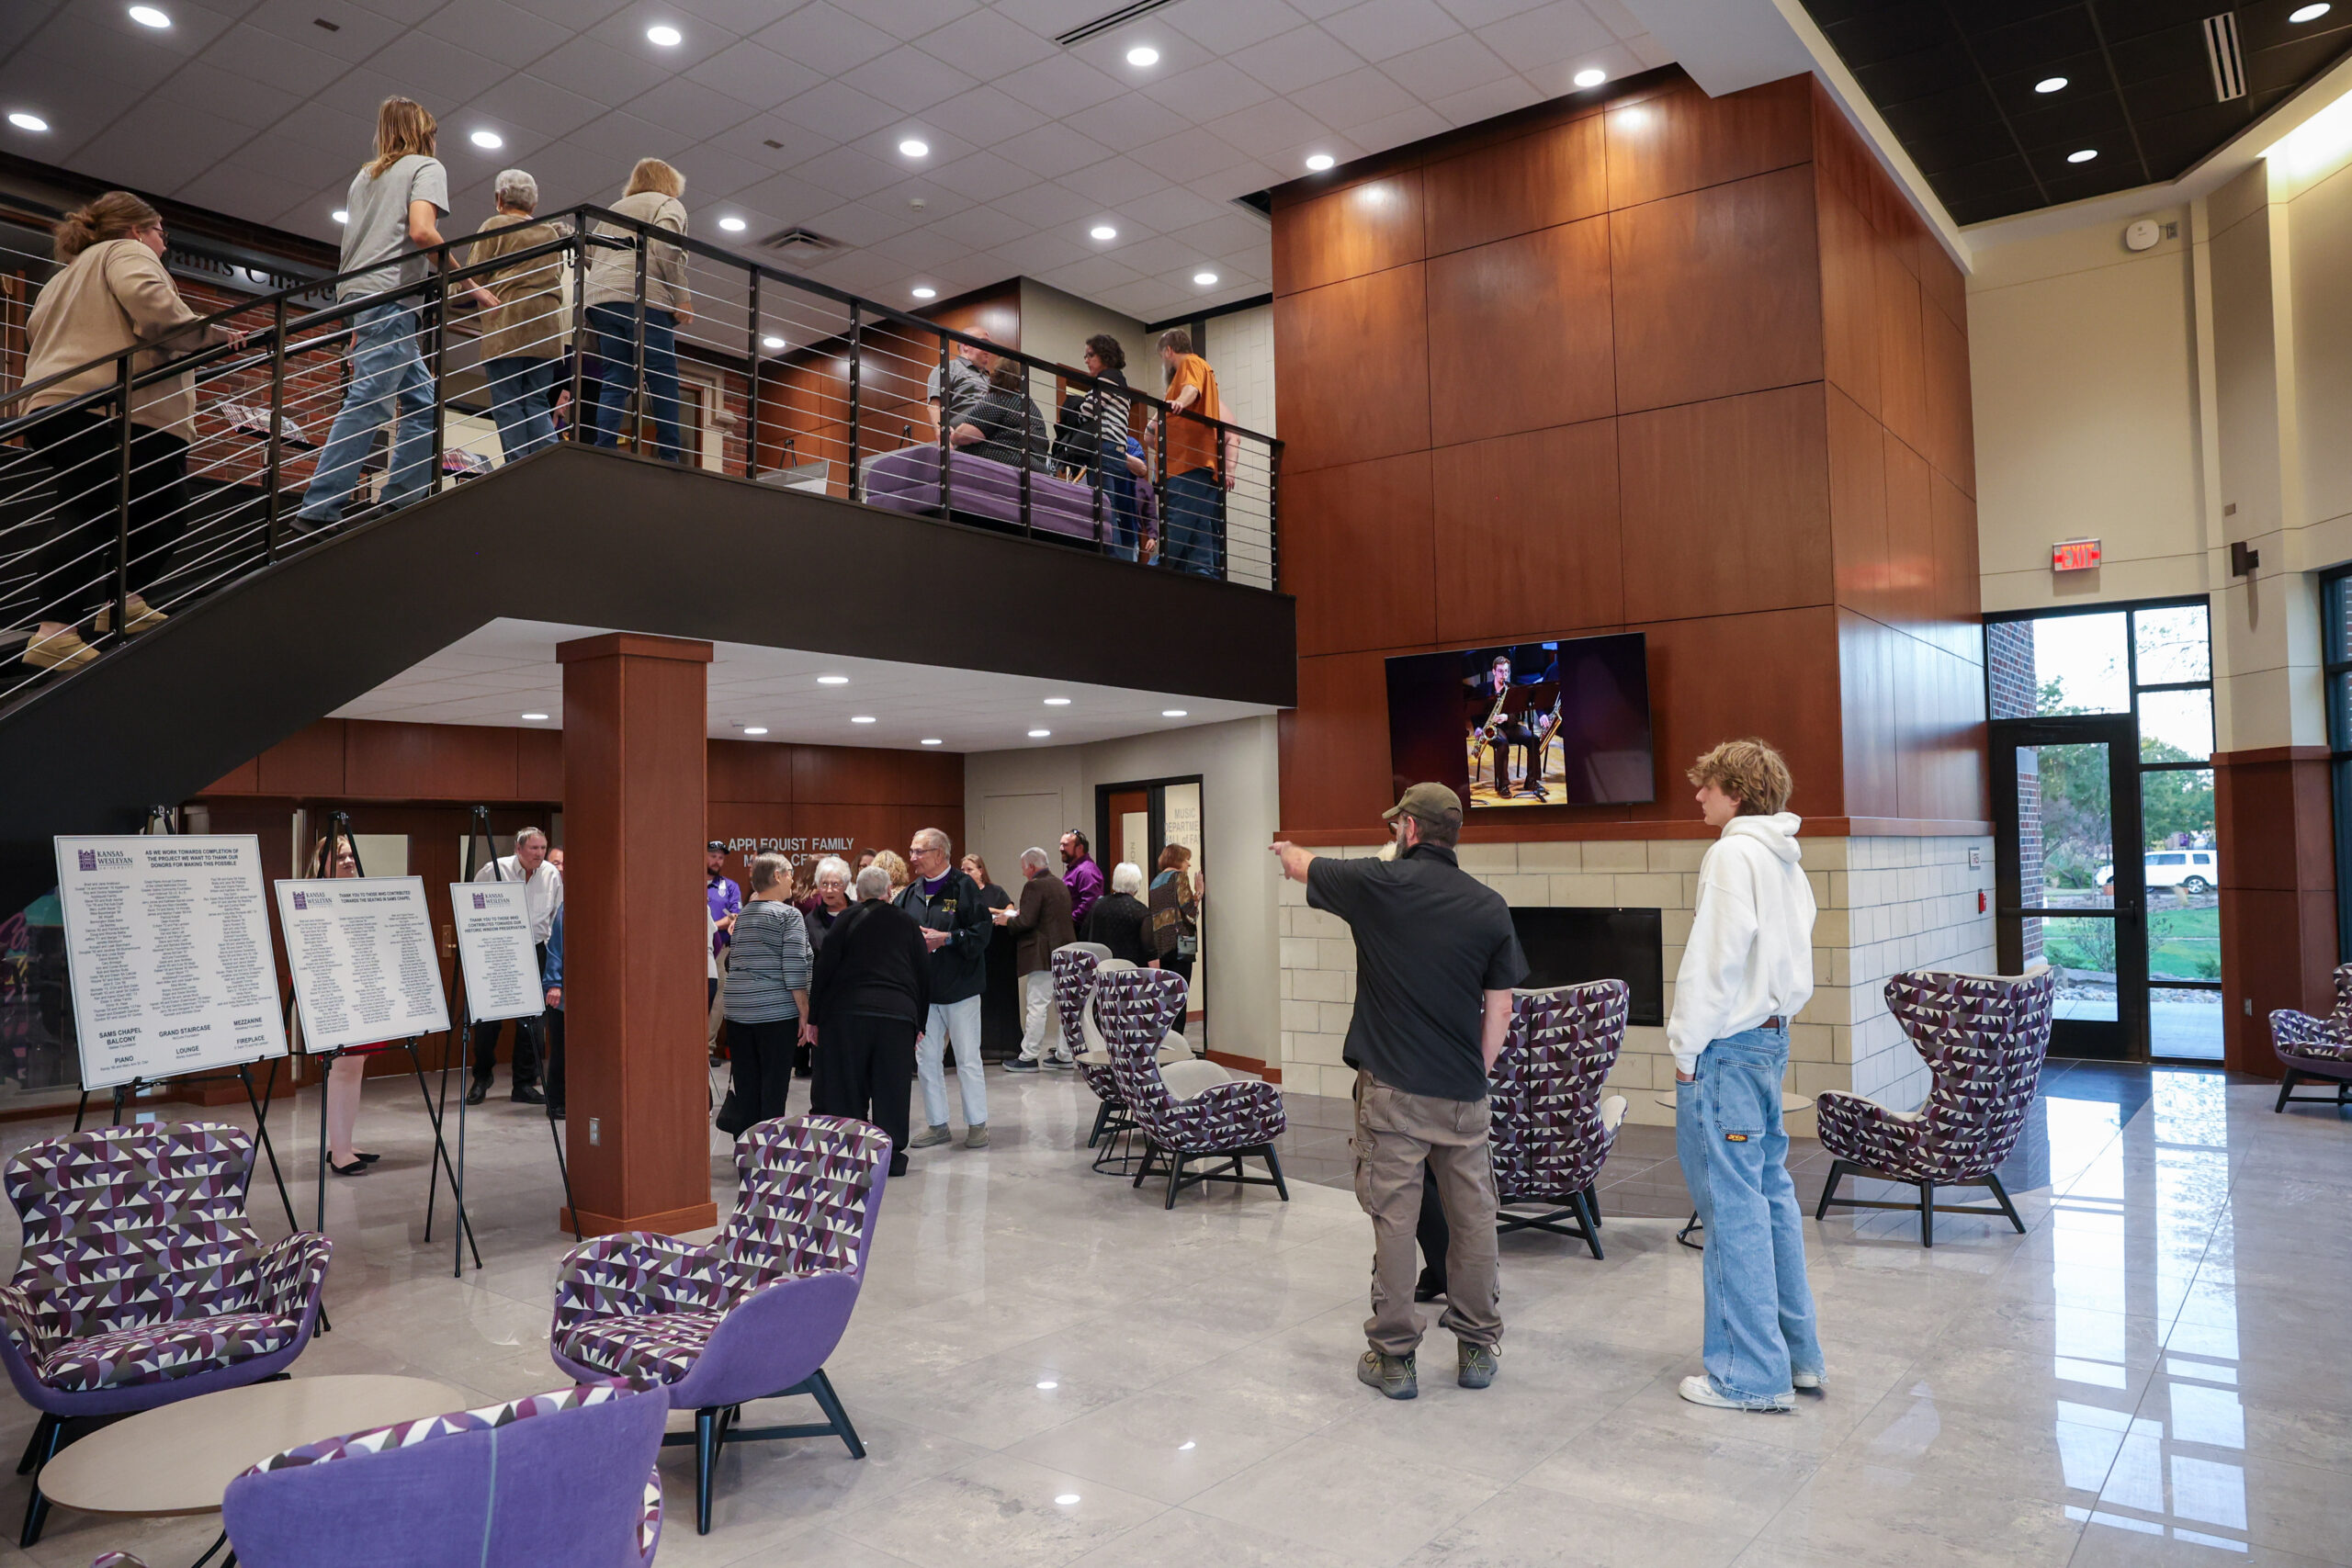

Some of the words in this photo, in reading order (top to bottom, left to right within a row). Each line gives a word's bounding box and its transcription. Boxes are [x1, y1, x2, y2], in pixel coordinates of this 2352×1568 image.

[2061, 544, 2095, 569] EXIT
[1174, 808, 1196, 818] MUSIC
[728, 838, 808, 851] APPLEQUIST
[811, 838, 854, 851] FAMILY
[233, 1017, 262, 1026] MEZZANINE
[99, 1031, 117, 1039] SAMS
[118, 1027, 142, 1036] CHAPEL
[159, 1029, 179, 1037] GRAND
[180, 1024, 211, 1034] STAIRCASE
[107, 1036, 136, 1045] BALCONY
[237, 1035, 265, 1044] FIREPLACE
[176, 1045, 199, 1055] LOUNGE
[114, 1055, 134, 1064] PIANO
